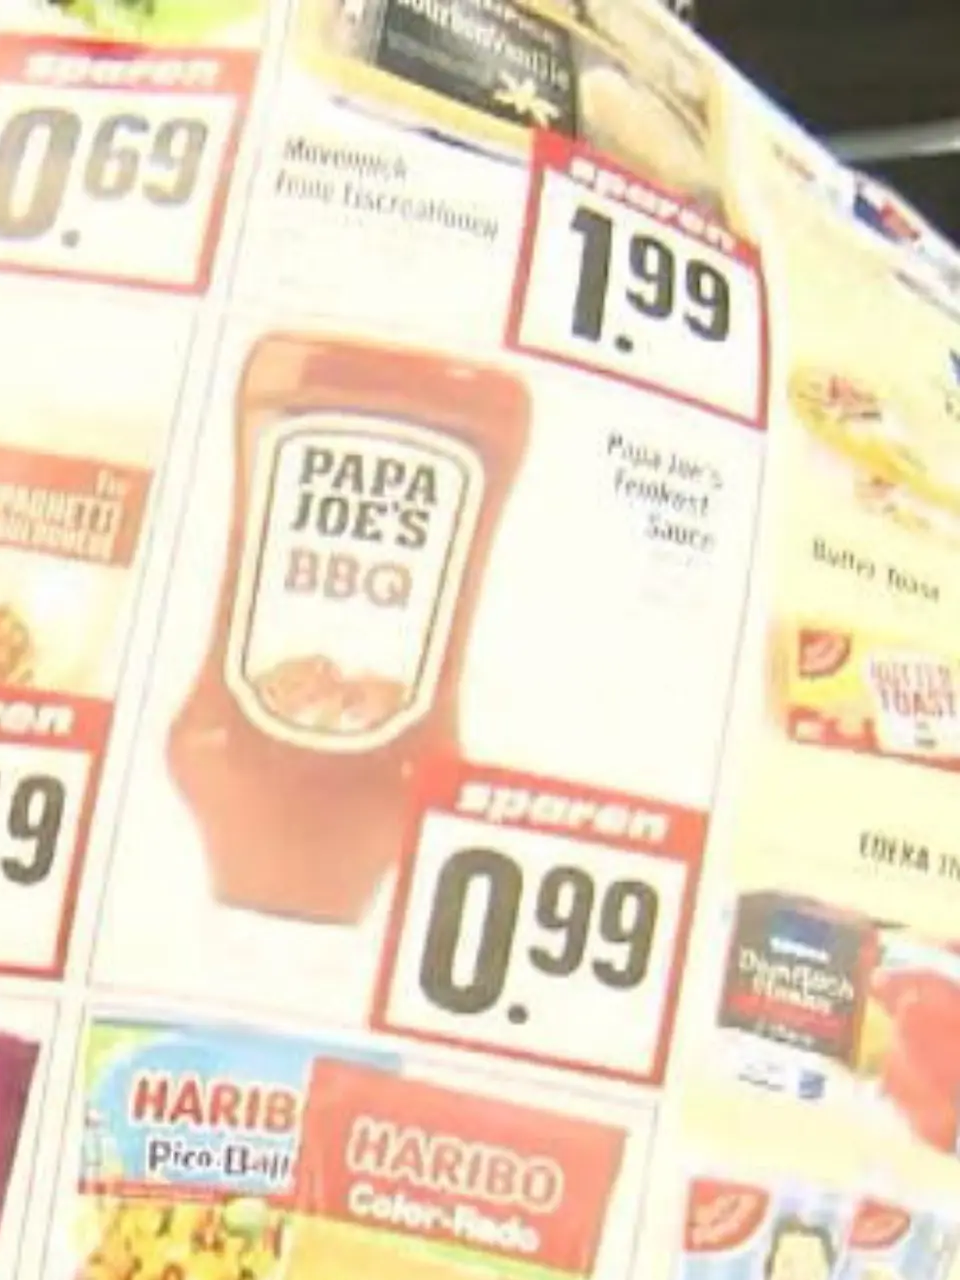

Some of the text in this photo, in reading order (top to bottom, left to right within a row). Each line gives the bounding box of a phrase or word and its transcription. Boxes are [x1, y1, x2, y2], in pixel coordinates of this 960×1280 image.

[570, 156, 738, 252] sparen
[570, 205, 732, 354] 1.99
[298, 446, 439, 506] PAPA
[289, 491, 432, 551] JOE'S
[284, 547, 413, 611] BBQ
[458, 783, 669, 844] sparen
[417, 845, 660, 1026] 0.99
[130, 1072, 298, 1136] HARIB
[145, 1137, 294, 1182] Pico-Ball
[349, 1116, 563, 1213] HARIBO
